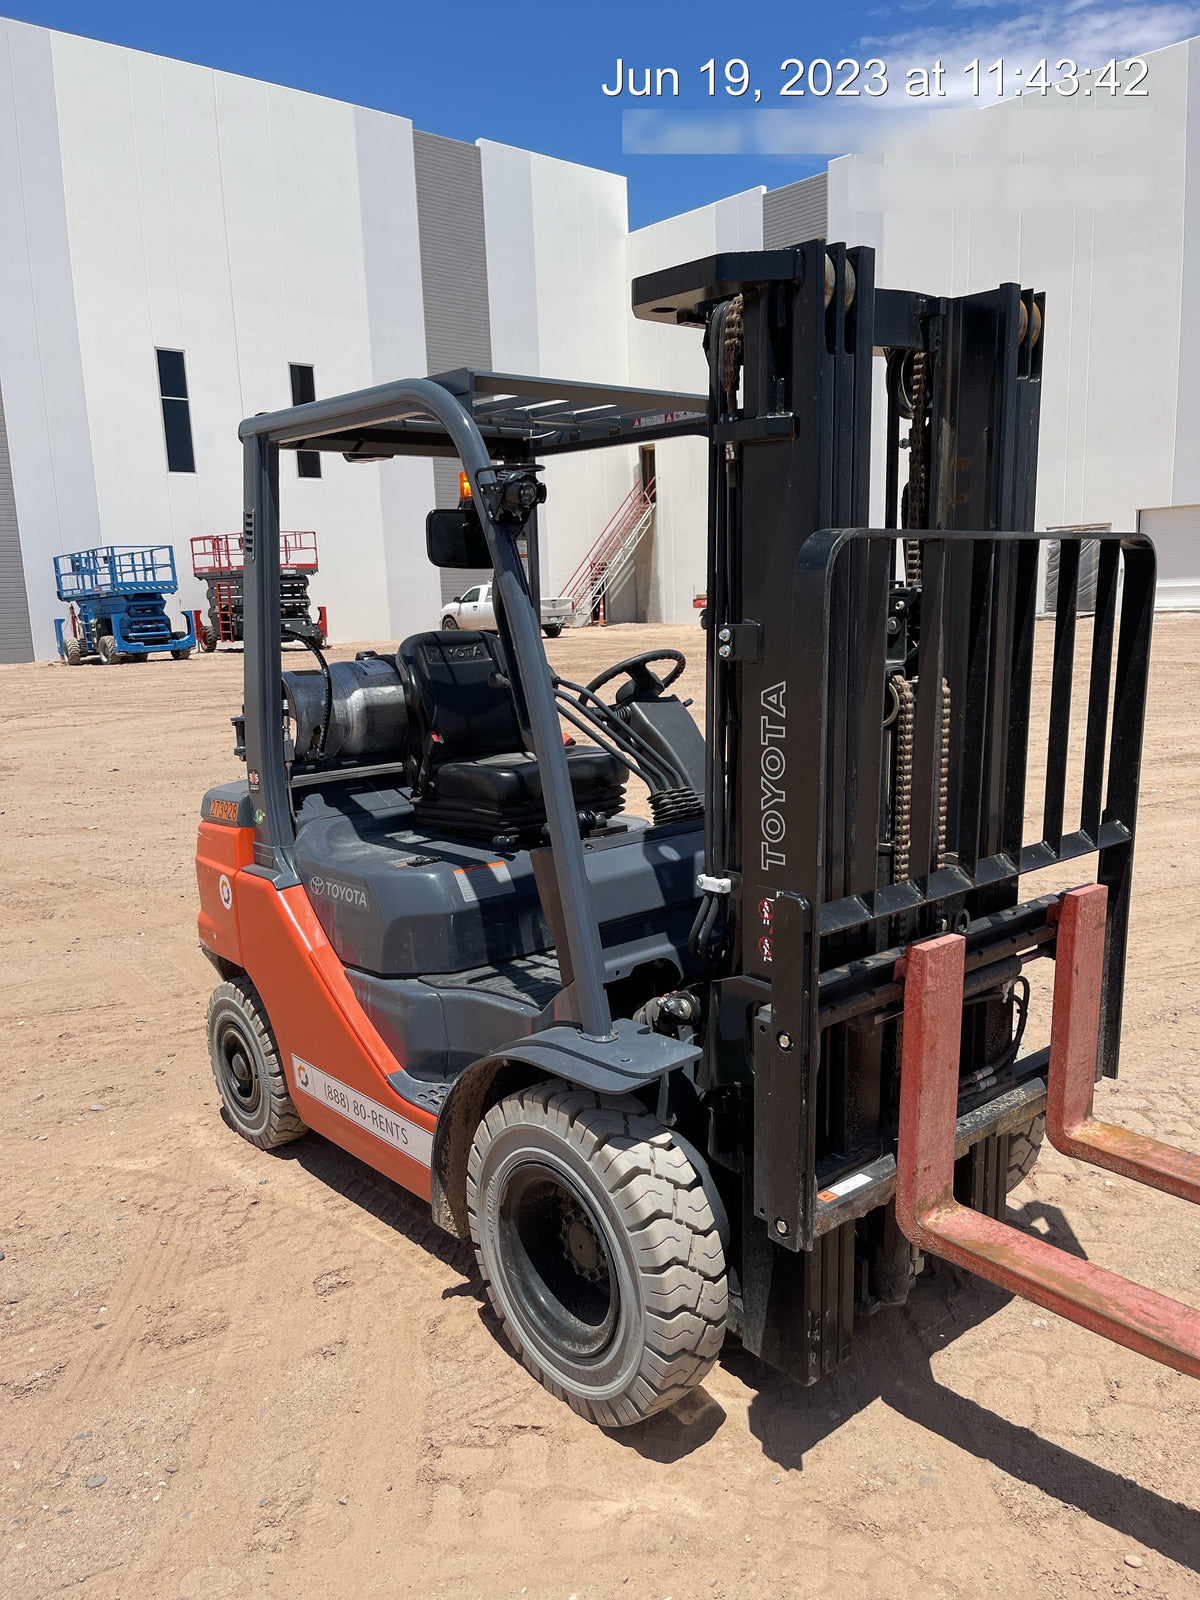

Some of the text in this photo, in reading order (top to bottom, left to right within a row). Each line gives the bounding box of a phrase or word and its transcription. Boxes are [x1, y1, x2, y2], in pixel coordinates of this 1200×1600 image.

[428, 646, 484, 660] TOYOTA
[760, 680, 787, 871] TOYOTA
[210, 799, 238, 821] 273928
[325, 881, 367, 907] TOYOTA
[323, 1081, 409, 1145] (888) 80-RENTS
